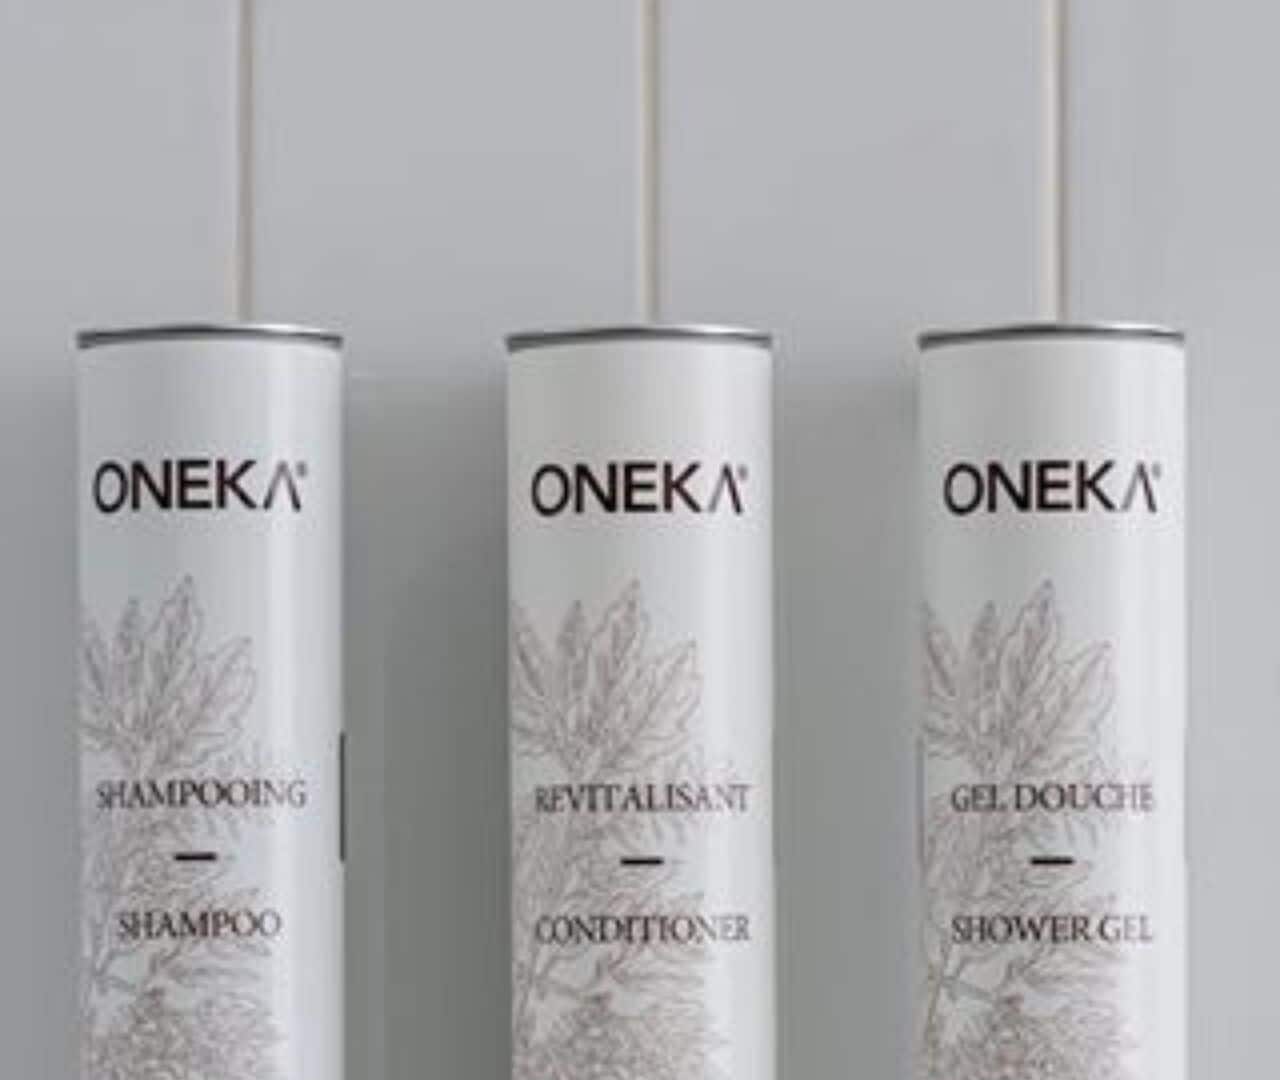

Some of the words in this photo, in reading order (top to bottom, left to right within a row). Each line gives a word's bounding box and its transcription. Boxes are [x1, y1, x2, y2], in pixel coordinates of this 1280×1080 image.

[93, 460, 301, 514] ONEKA
[531, 461, 743, 517] ONEKA
[943, 460, 1157, 516] ONEKA
[96, 778, 307, 809] SHAMPOOING
[534, 783, 752, 813] REVITALISANT
[950, 783, 1008, 812] GEL
[1015, 783, 1153, 813] DOUCHE
[118, 909, 282, 940] SHAMPOO
[535, 914, 751, 944] CONDITIONER
[951, 914, 1090, 944] SHOWER
[1099, 914, 1153, 942] GEL
